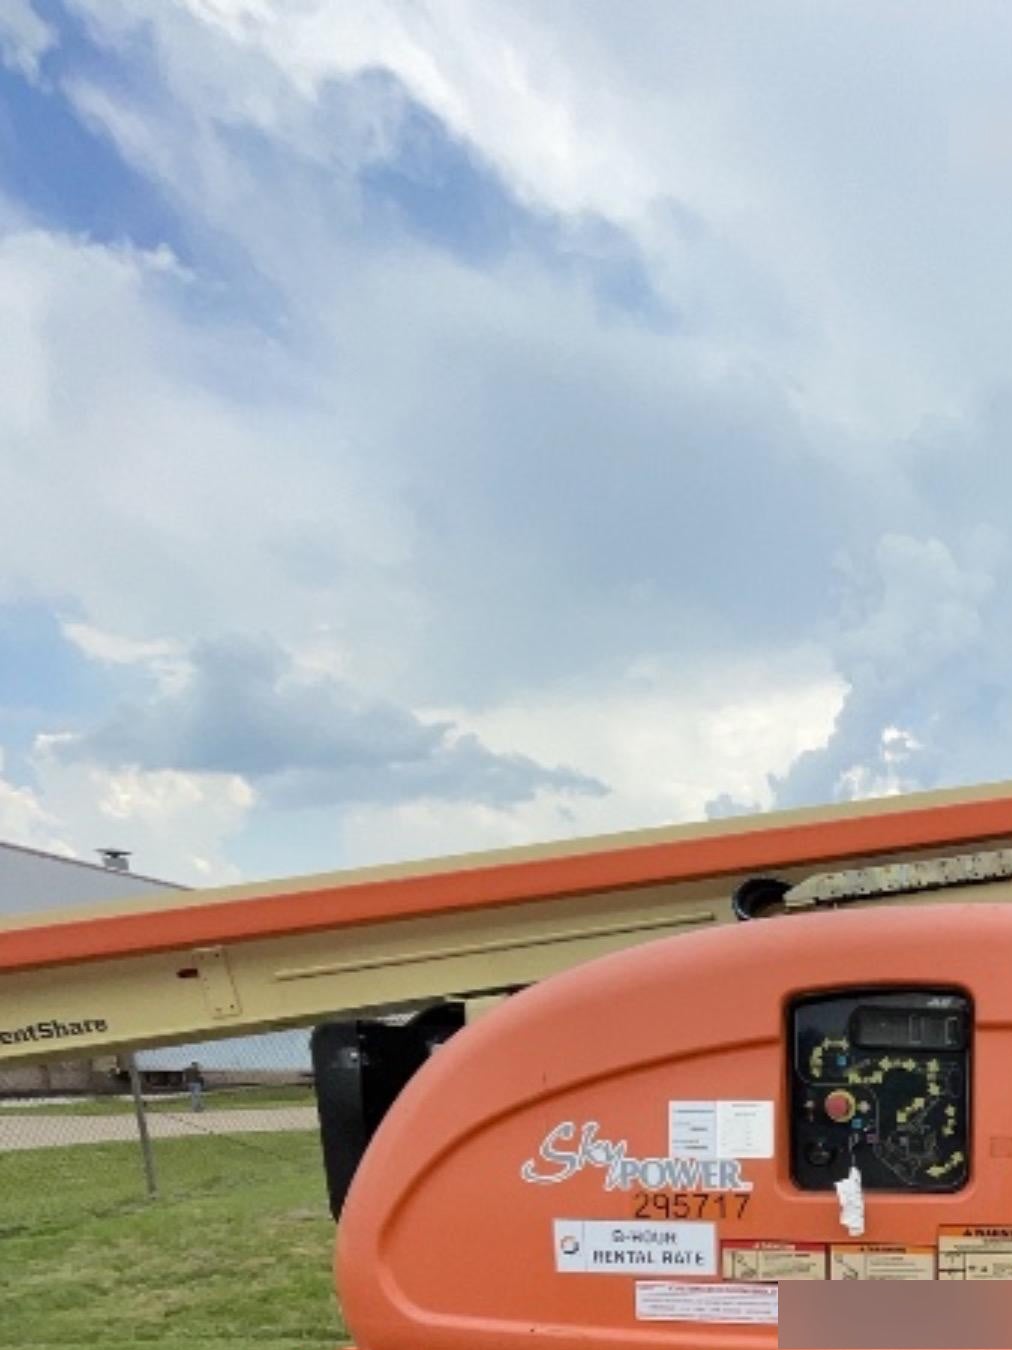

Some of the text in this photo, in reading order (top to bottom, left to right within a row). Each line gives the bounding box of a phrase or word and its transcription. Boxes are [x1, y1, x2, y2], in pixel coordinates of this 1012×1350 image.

[521, 1120, 628, 1192] Sky
[617, 1157, 745, 1191] POWER
[633, 1193, 752, 1220] 295717
[593, 1250, 706, 1266] RENTAL RATE
